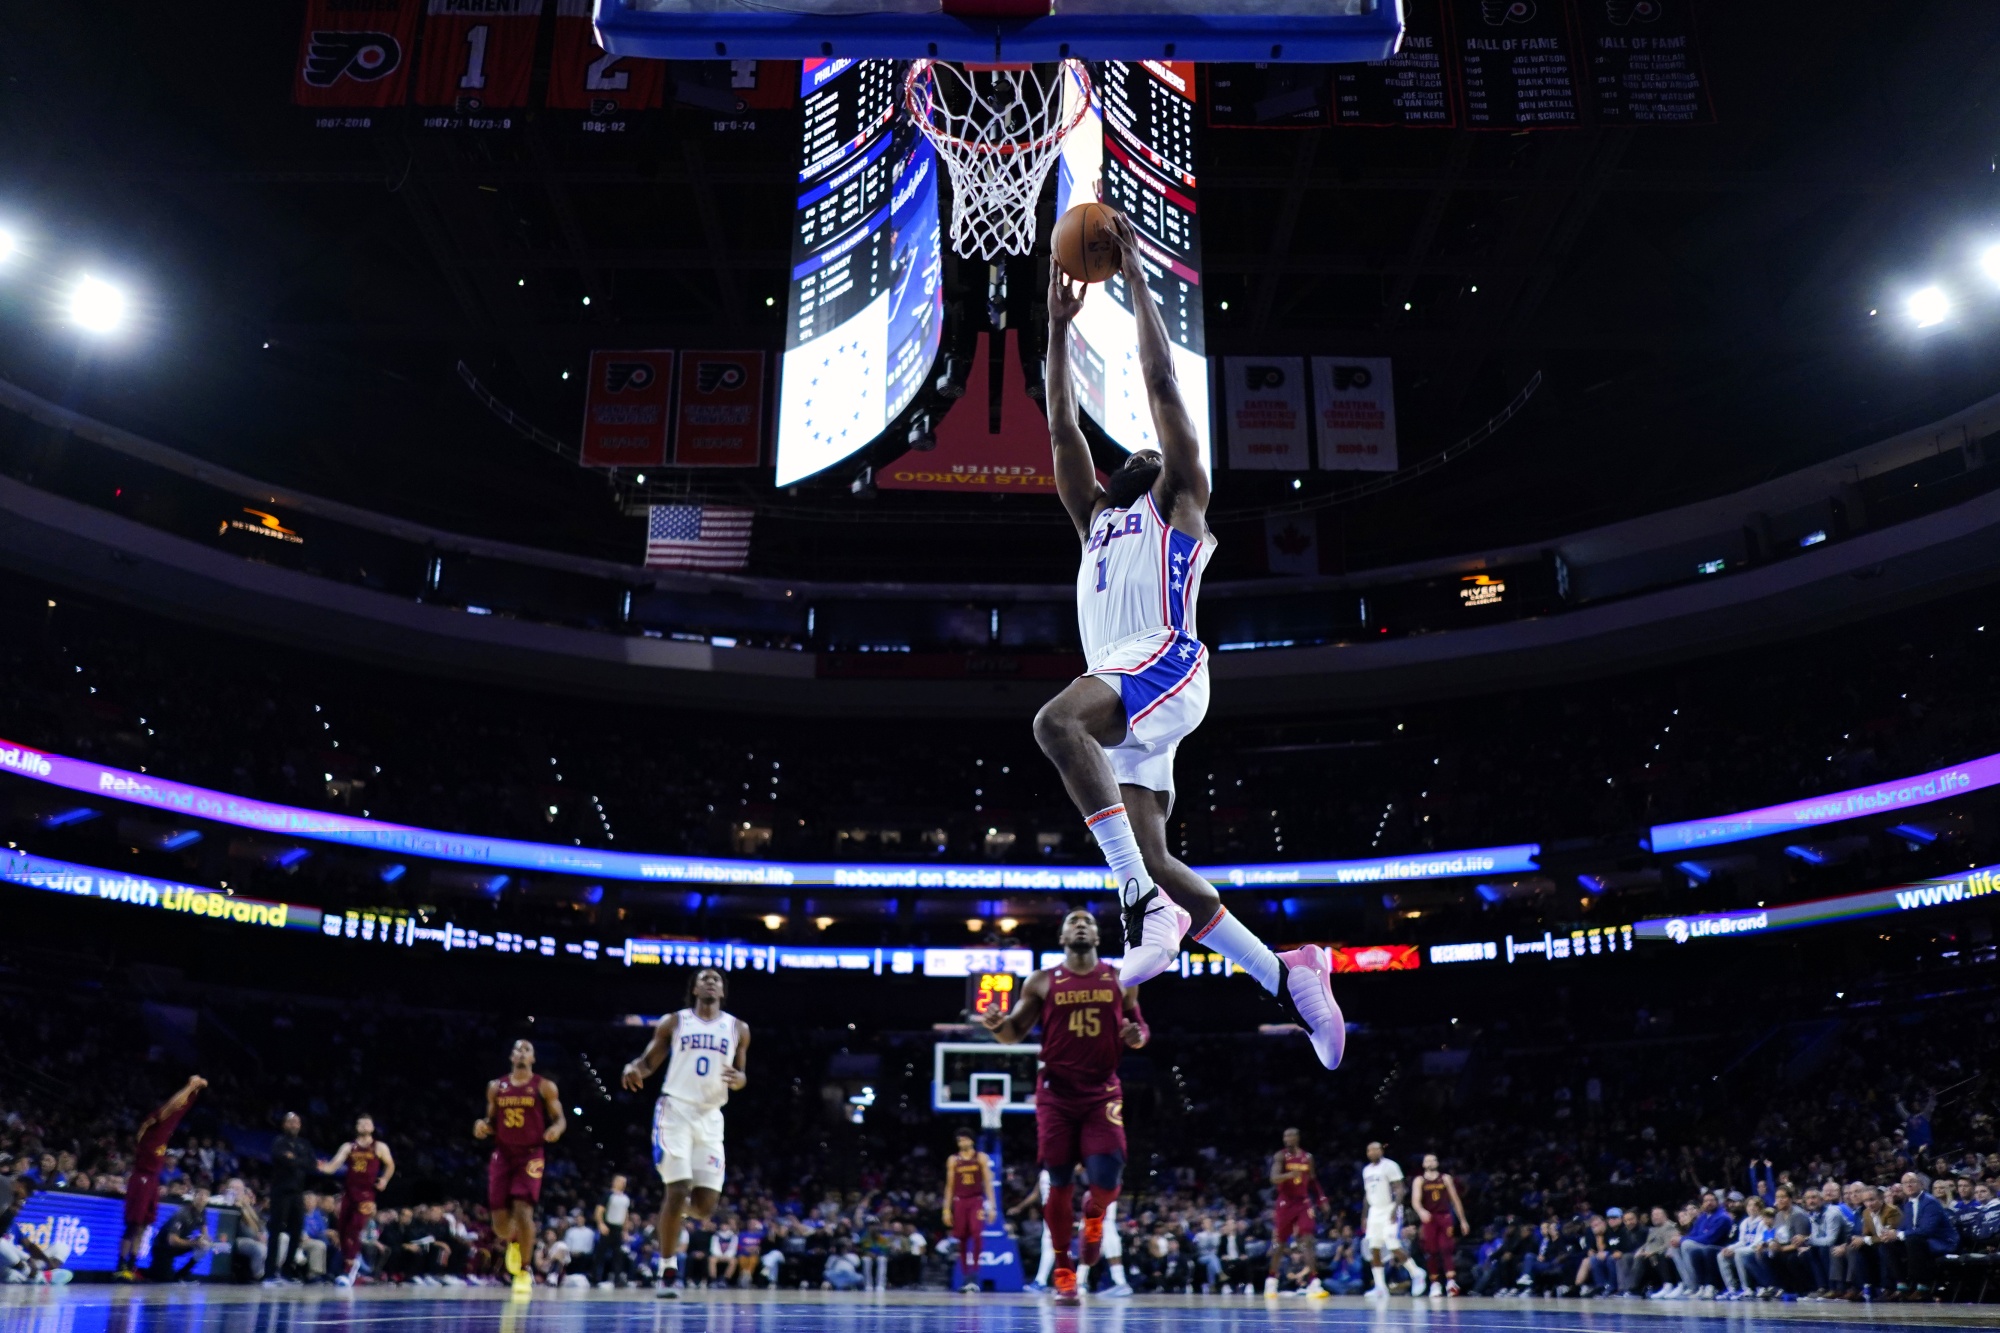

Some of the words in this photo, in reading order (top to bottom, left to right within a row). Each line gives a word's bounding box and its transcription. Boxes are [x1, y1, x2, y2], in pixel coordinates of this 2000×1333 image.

[1466, 37, 1499, 50] HALL
[1502, 38, 1518, 50] OF
[1521, 37, 1559, 50] FAME
[1632, 37, 1648, 49] OF
[1652, 36, 1686, 49] FAME
[460, 25, 488, 89] 1
[1538, 111, 1576, 121] SCHULTZ
[1096, 557, 1107, 593] 1
[100, 771, 194, 808] Rebound
[197, 797, 223, 816] on
[640, 863, 795, 885] www.lifebrand.life
[834, 868, 917, 887] Rebound
[918, 872, 944, 887] on
[944, 869, 1001, 888] Social
[1003, 870, 1061, 889] Media
[1062, 870, 1103, 889] with
[1336, 857, 1494, 883] www.lifebrand.life
[98, 875, 159, 907] with
[162, 884, 288, 929] LifeBrand
[1690, 912, 1767, 938] LifeBrand
[1055, 989, 1114, 1006] CLEVELAND
[1068, 1008, 1102, 1038] 45
[680, 1033, 729, 1056] PHILA
[696, 1056, 710, 1077] 0
[503, 1108, 526, 1128] 35
